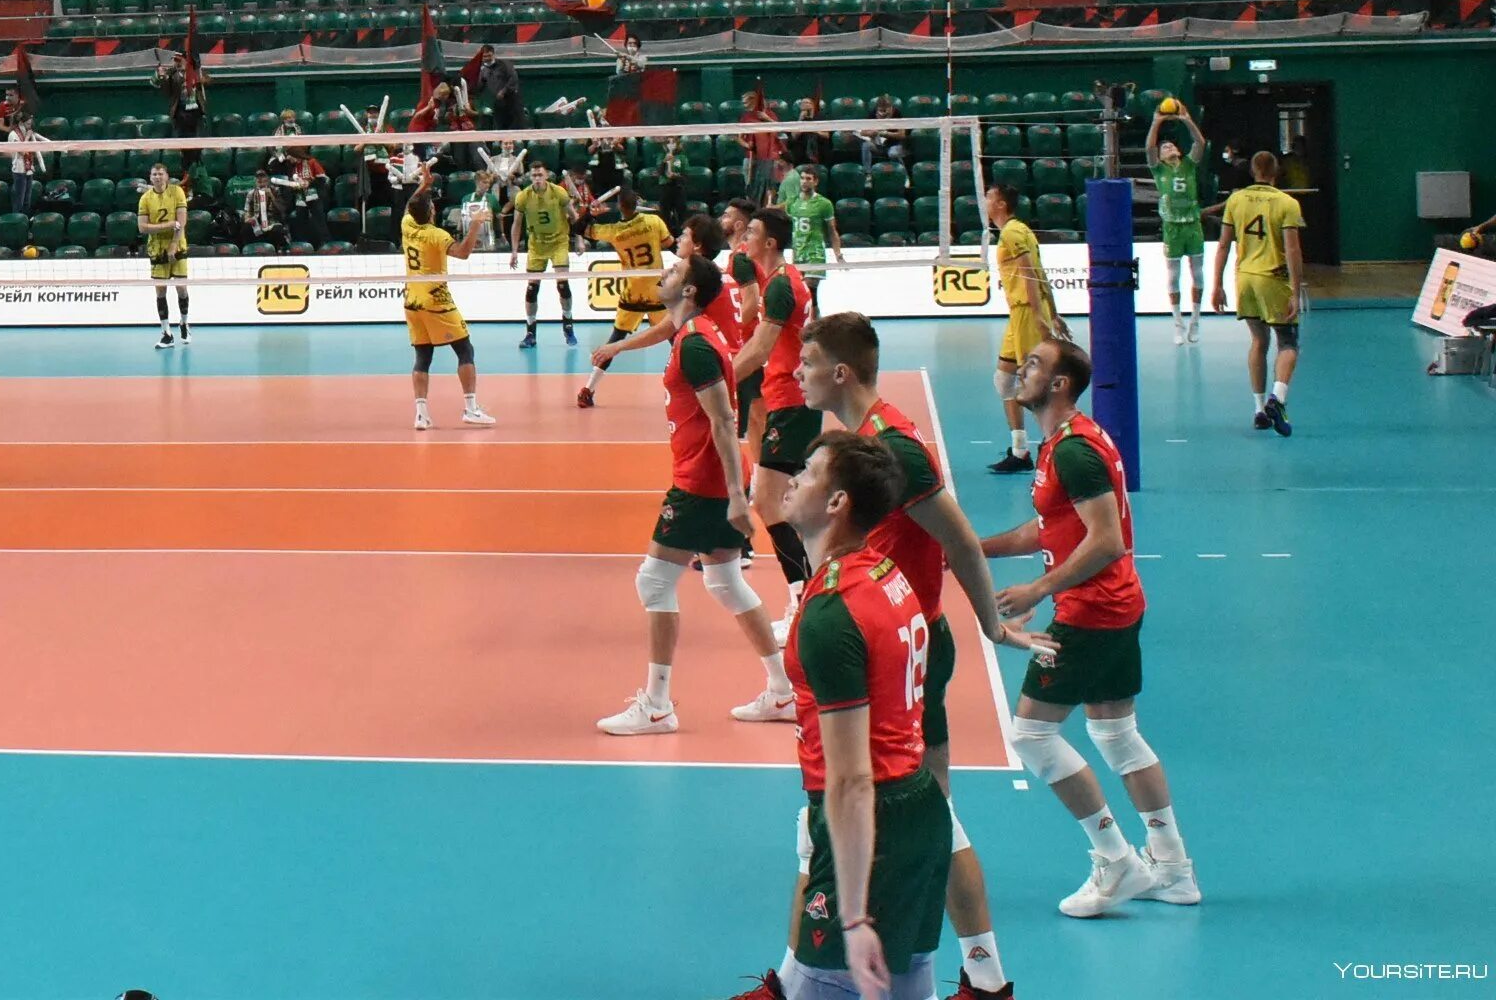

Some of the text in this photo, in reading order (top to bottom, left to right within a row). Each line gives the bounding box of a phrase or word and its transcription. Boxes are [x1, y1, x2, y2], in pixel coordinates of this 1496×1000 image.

[158, 208, 169, 222] 2
[538, 211, 550, 225] 3
[1243, 214, 1266, 240] 4
[407, 246, 421, 270] 8
[624, 243, 654, 267] 13
[316, 284, 353, 299] РЕЙЛ
[941, 269, 981, 291] RC
[37, 291, 120, 302] КОНТИНЕНТ
[729, 287, 743, 324] 5
[898, 612, 929, 711] 18
